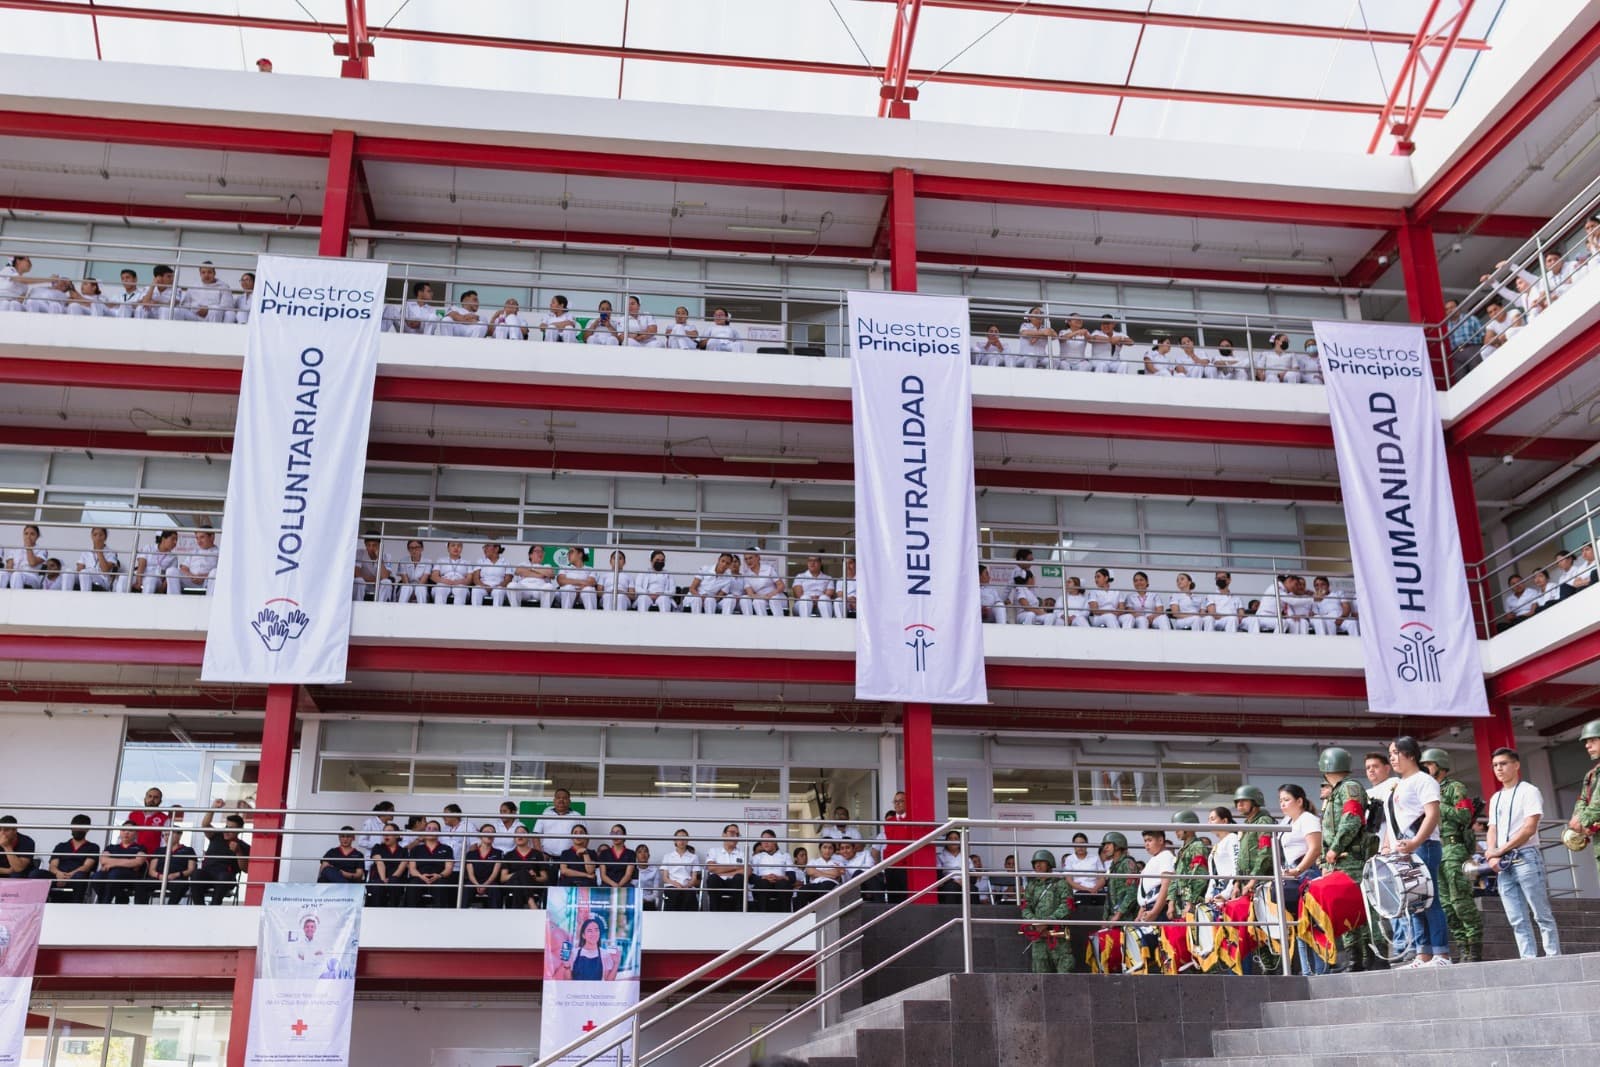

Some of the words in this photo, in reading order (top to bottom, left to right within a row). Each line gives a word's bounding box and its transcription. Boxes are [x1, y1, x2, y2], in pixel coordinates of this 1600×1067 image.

[263, 280, 374, 303] Nuestros
[260, 299, 371, 321] Principios
[858, 317, 960, 338] Nuestros
[859, 335, 960, 356] Principios
[1323, 342, 1419, 362] Nuestros
[1328, 358, 1422, 379] Principios
[275, 347, 324, 576] VOLUNTARIADO
[901, 375, 931, 595] NEUTRALIDAD
[1368, 391, 1426, 613] HUMANIDAD
